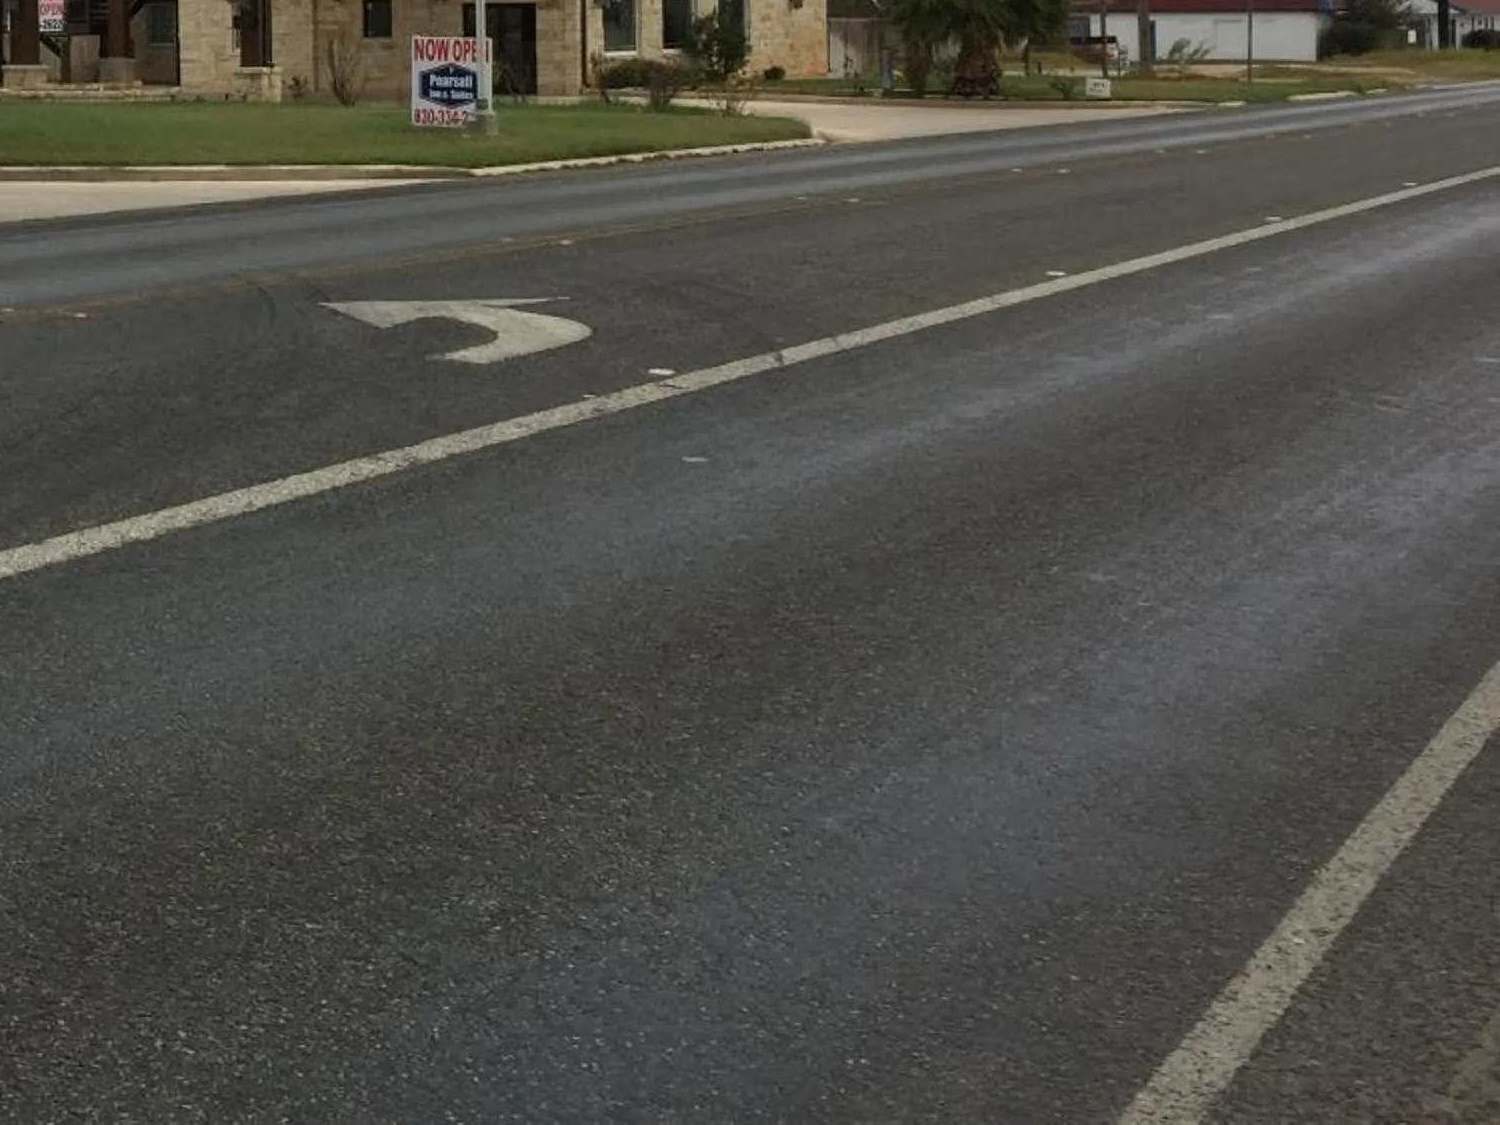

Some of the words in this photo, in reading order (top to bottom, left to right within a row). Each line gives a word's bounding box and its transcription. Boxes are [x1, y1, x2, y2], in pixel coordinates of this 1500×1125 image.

[414, 38, 450, 61] NOW
[430, 74, 473, 88] Pearsall
[414, 108, 468, 124] 830-334-2
